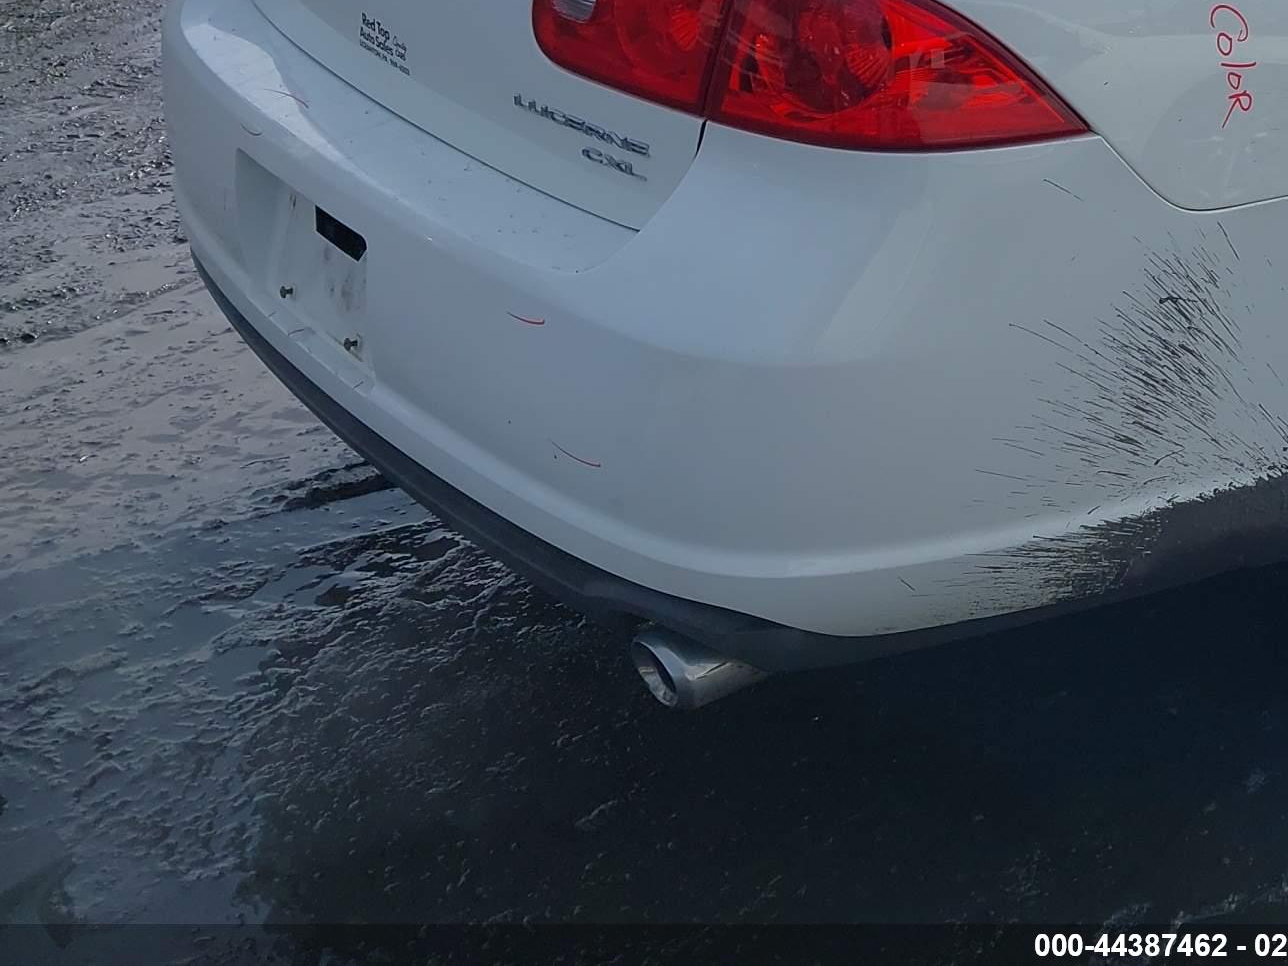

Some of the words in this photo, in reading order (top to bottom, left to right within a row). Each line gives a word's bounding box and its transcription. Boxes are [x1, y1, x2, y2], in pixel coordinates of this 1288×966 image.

[360, 26, 375, 45] Auto
[376, 35, 393, 56] Sales
[361, 12, 376, 32] Red
[376, 20, 390, 46] Top
[514, 94, 650, 157] LUCERNE
[582, 148, 647, 181] CXL
